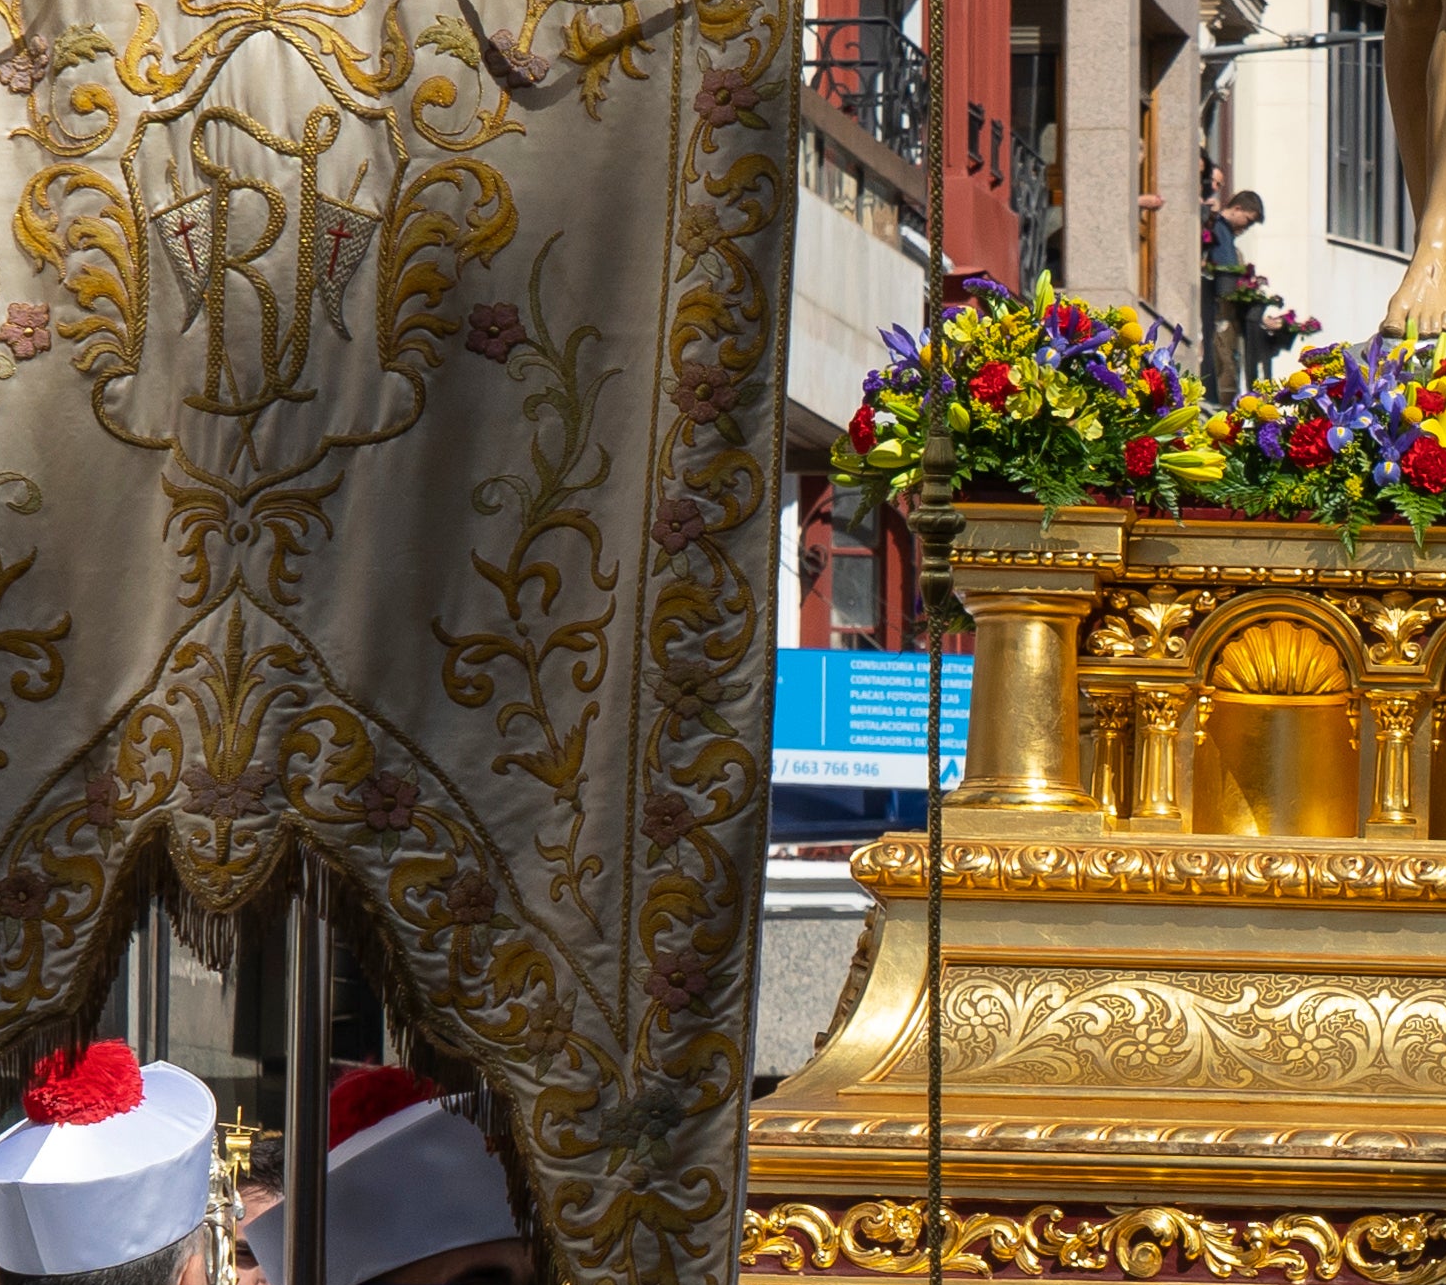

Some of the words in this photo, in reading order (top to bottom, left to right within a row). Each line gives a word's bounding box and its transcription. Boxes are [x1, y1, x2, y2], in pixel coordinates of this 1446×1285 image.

[793, 760, 819, 775] 663
[823, 761, 849, 775] 766
[853, 762, 880, 777] 946
